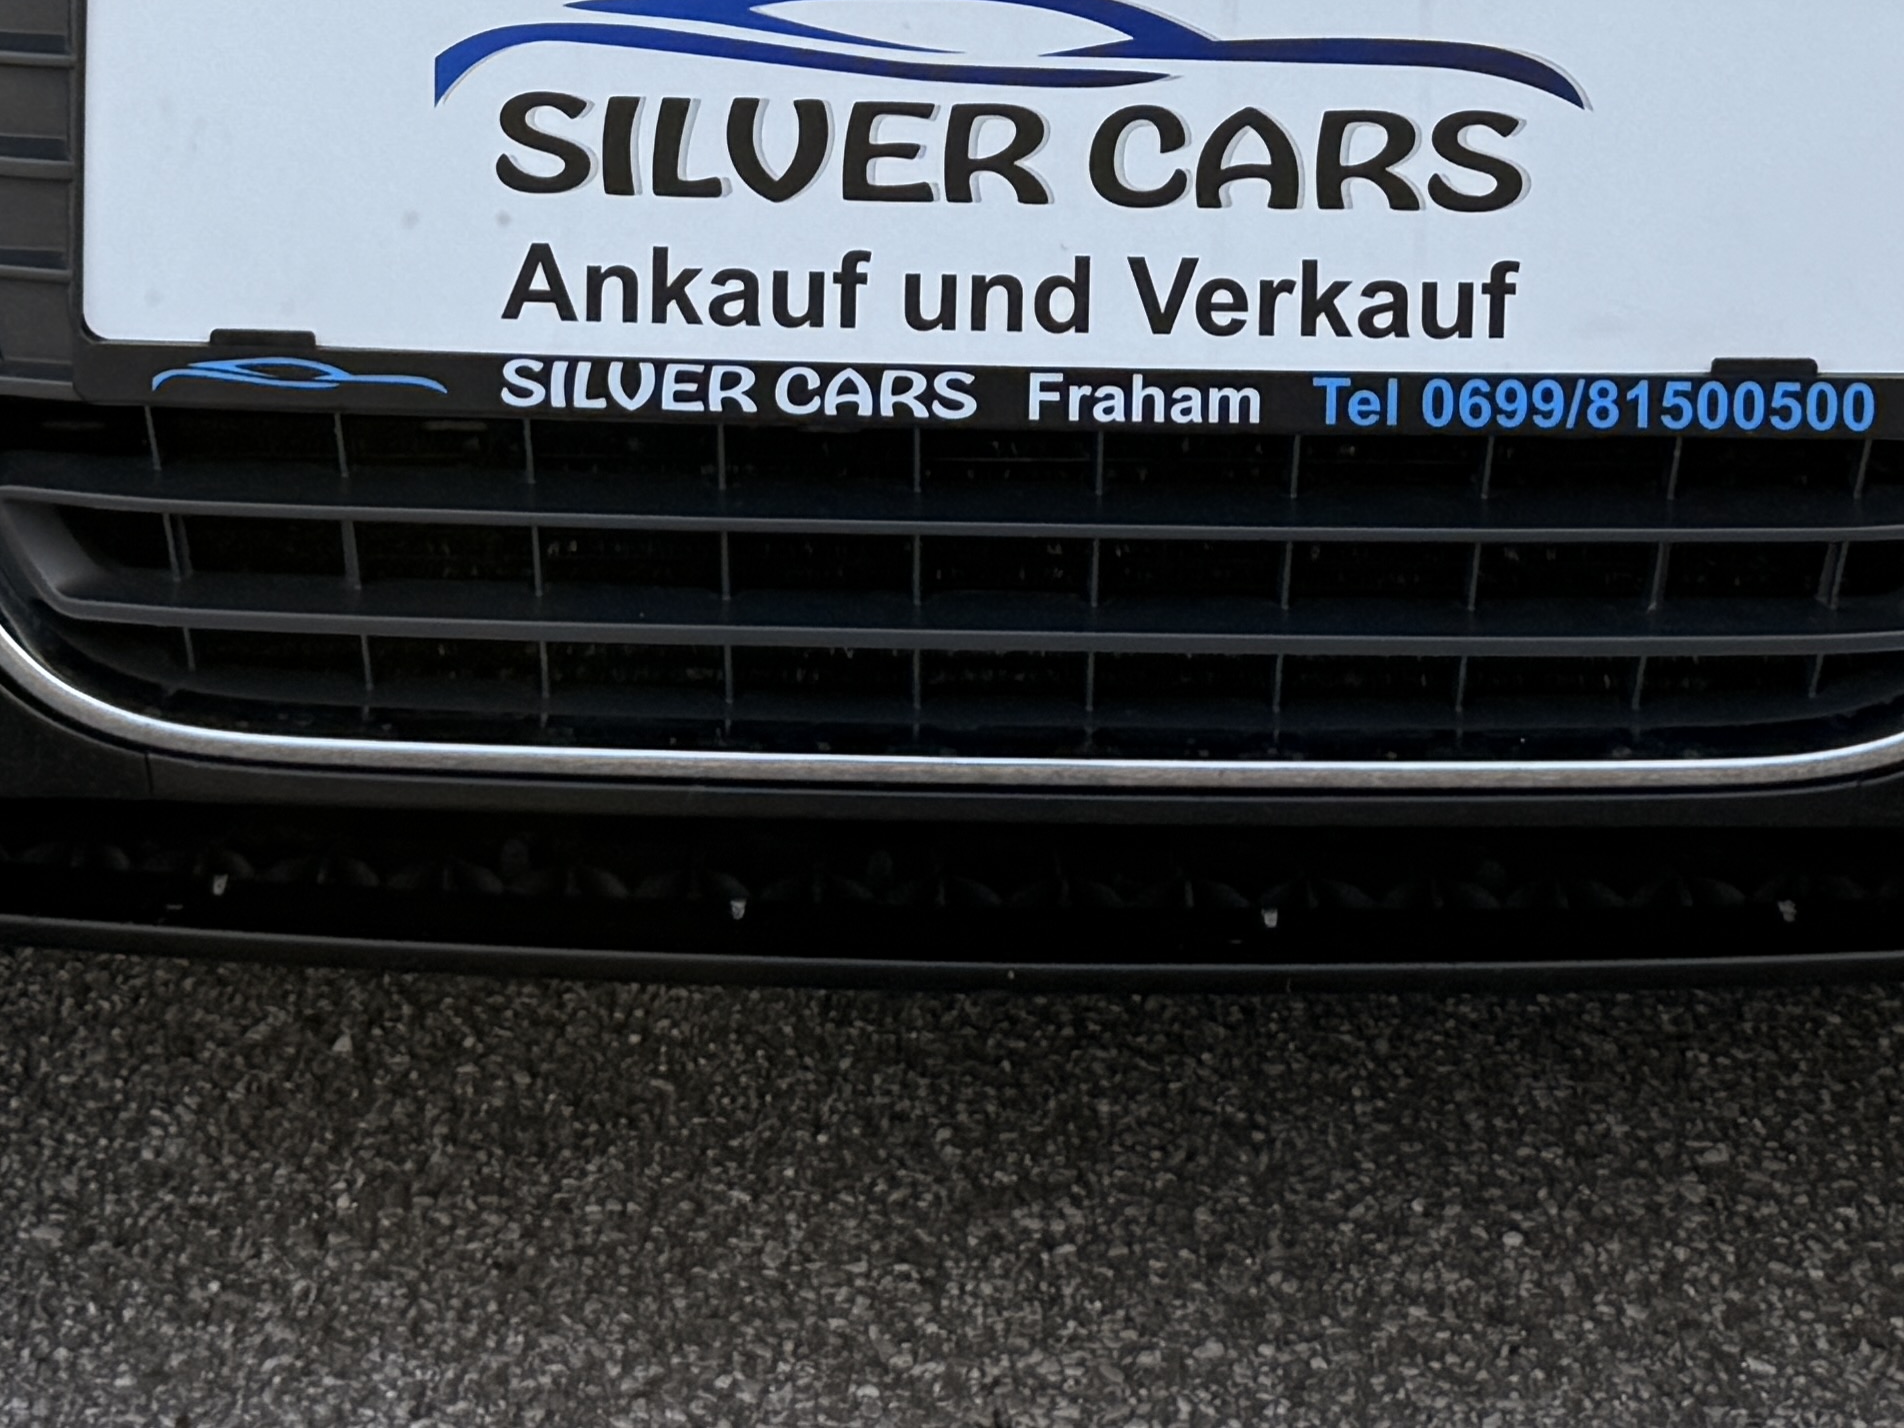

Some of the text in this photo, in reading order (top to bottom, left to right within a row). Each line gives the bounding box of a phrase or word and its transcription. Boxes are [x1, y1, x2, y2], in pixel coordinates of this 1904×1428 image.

[495, 90, 1530, 213] SILVER CARS
[500, 242, 1521, 339] Ankauf und Verkauf
[499, 358, 1876, 433] SILVER CARS Fraham Tel 0699/81500500
